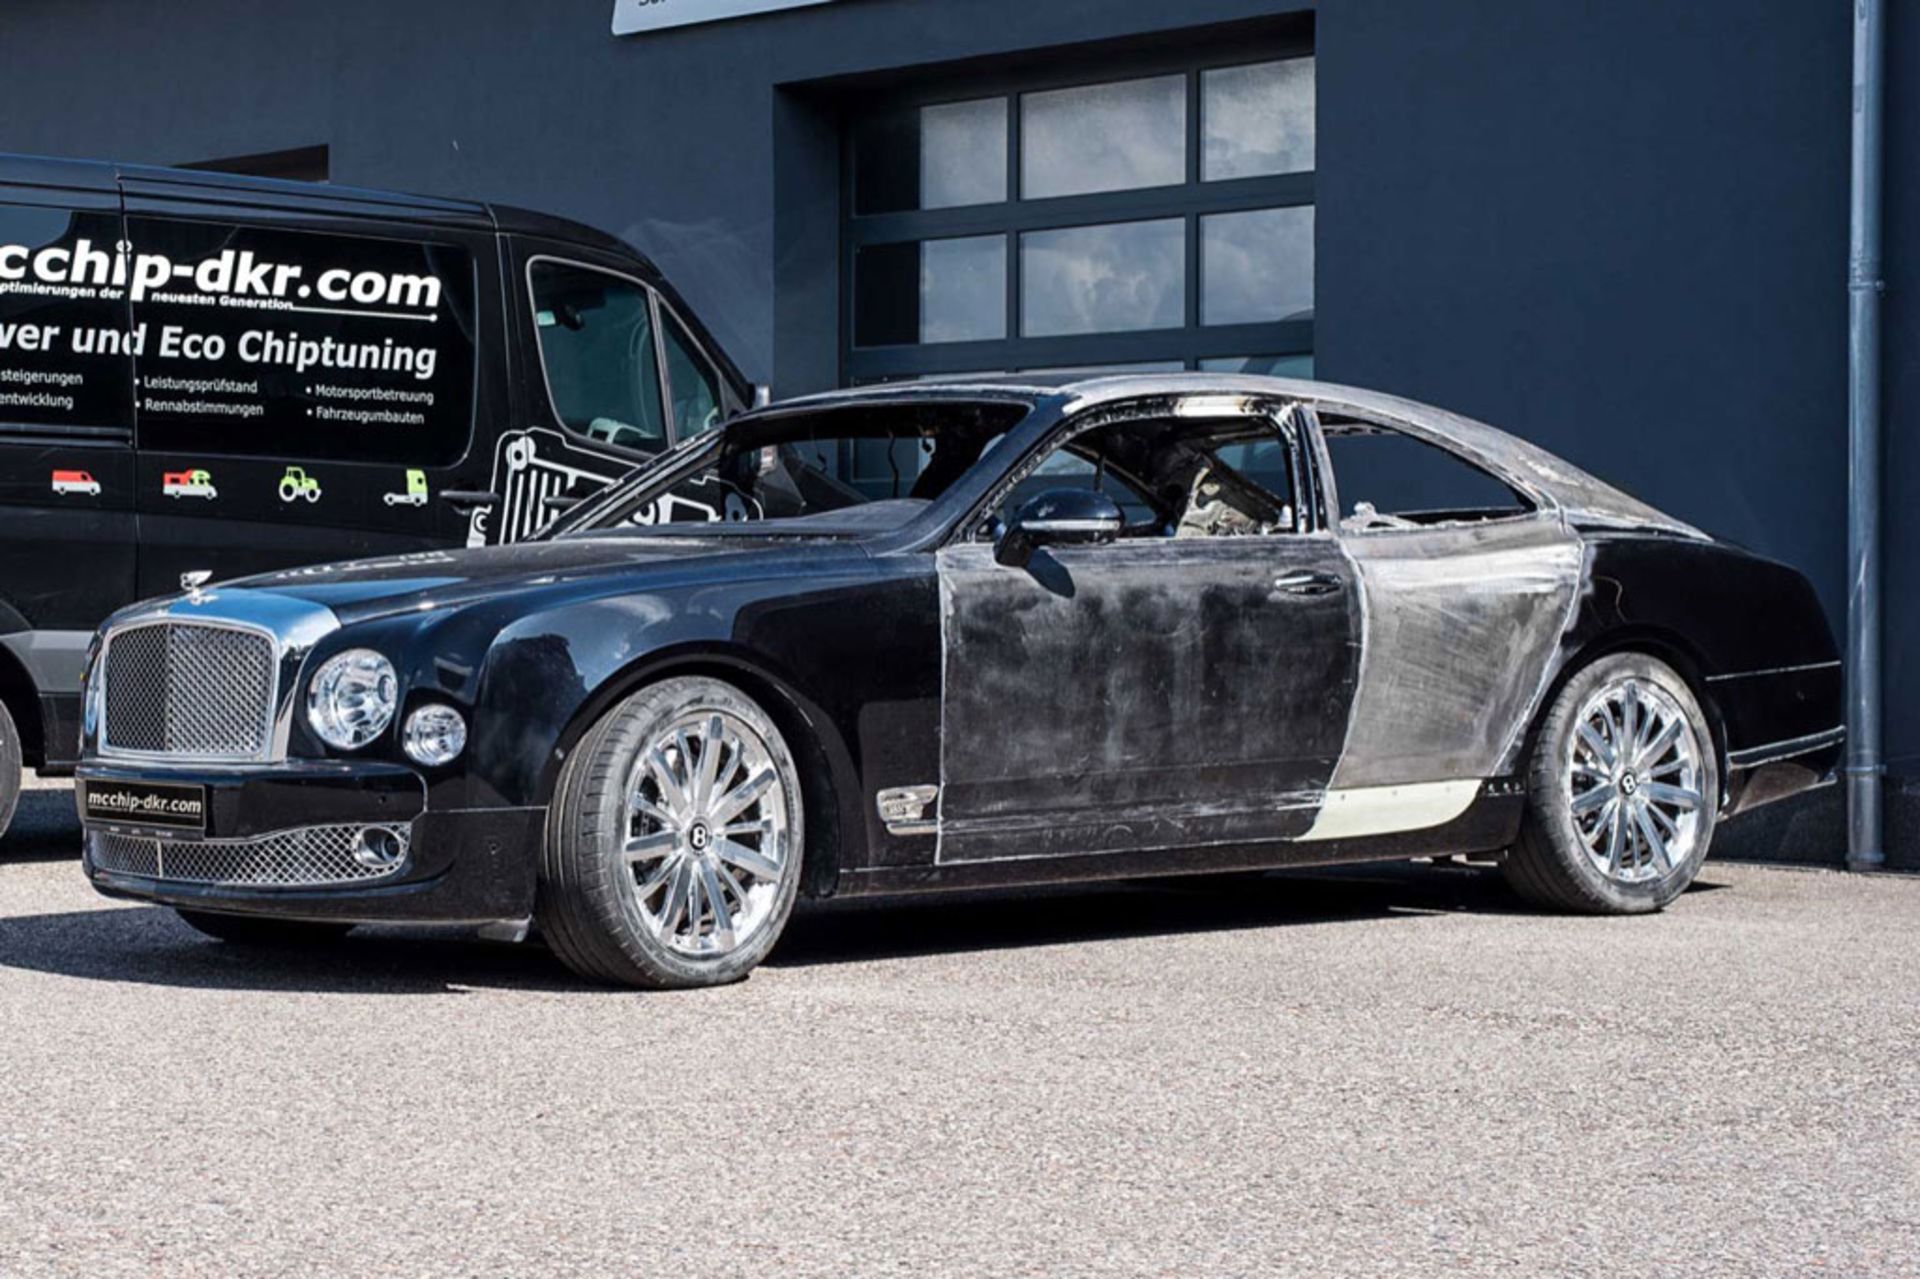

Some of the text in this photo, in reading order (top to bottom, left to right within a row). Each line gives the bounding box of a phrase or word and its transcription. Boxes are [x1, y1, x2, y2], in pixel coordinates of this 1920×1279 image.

[99, 286, 124, 300] der
[151, 292, 216, 306] neuesten
[219, 294, 293, 310] Generation
[72, 322, 147, 356] und
[159, 325, 226, 361] Eco
[238, 329, 436, 380] Chiptuning
[143, 375, 258, 394] Leistungsprüfstand
[315, 384, 434, 406] Motorsportbetreuung
[145, 397, 264, 418] Rennabstimmungen
[316, 406, 424, 425] Fahrzeugumbauten
[88, 790, 202, 814] mcchip-dkr.com
